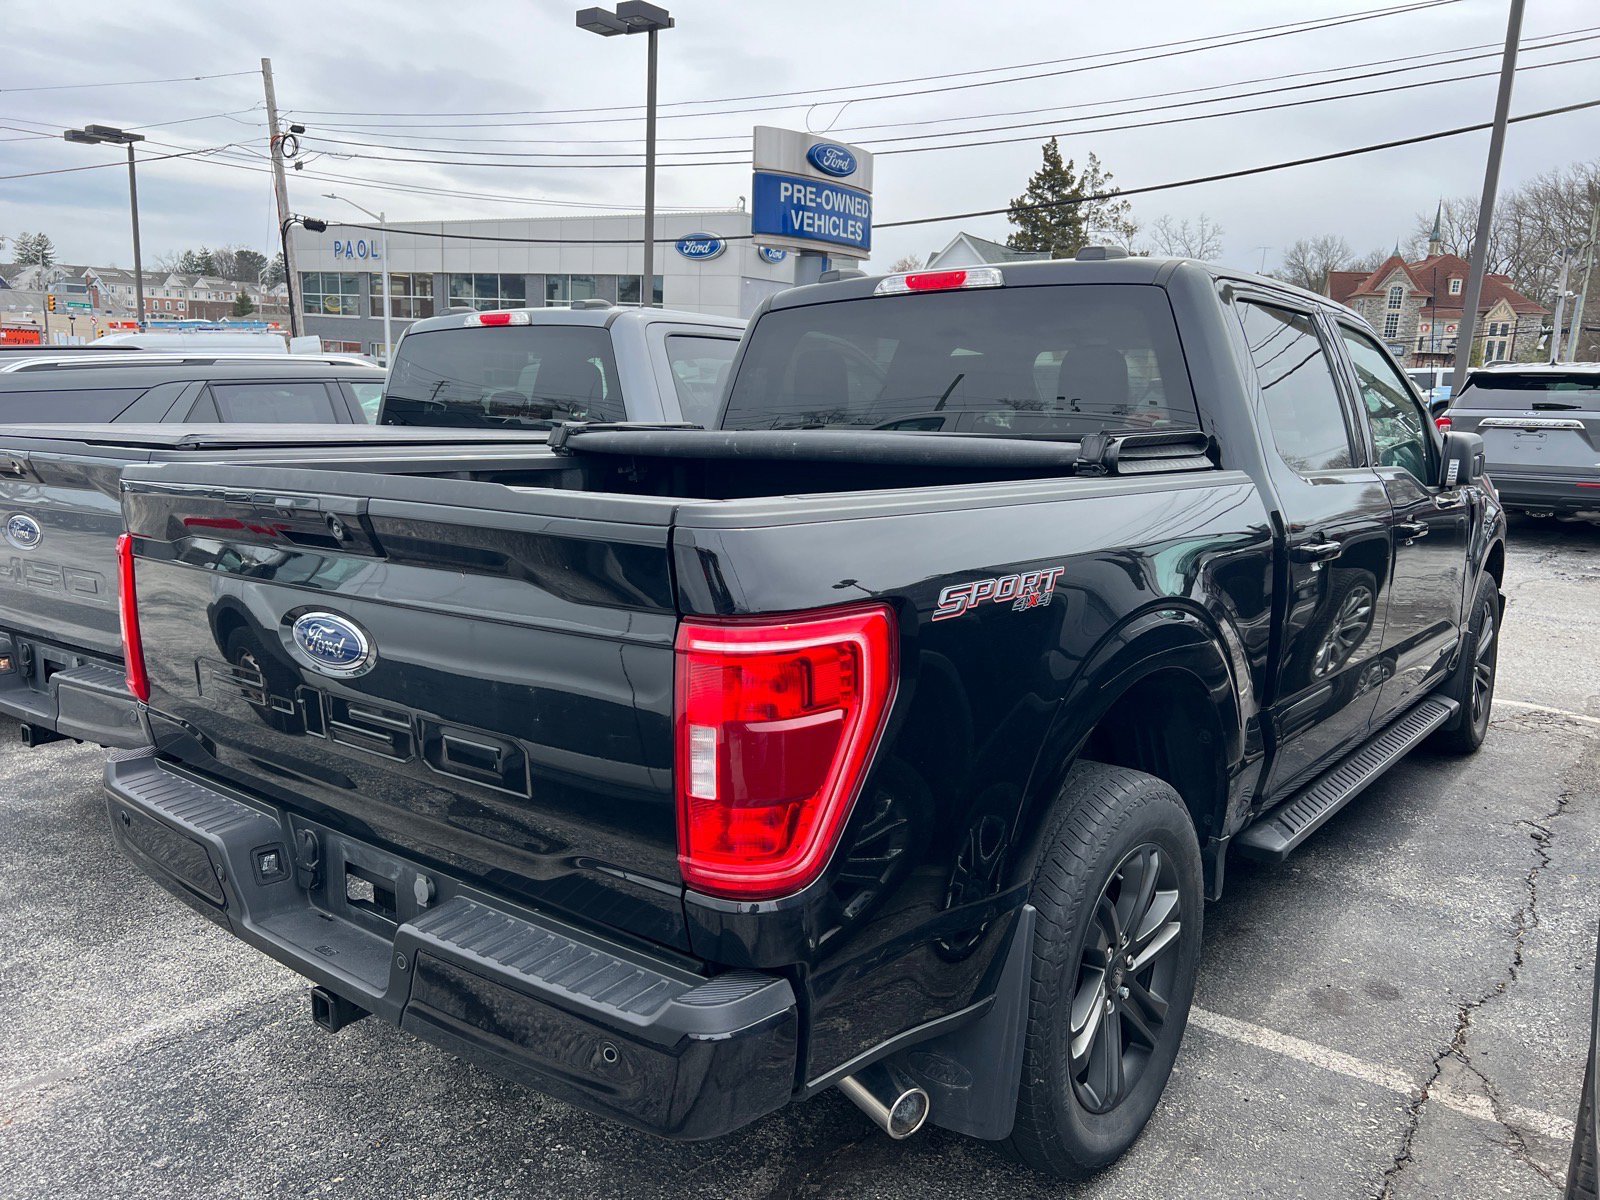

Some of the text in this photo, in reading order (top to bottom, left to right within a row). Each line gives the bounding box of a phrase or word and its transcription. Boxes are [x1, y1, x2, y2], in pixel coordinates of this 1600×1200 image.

[822, 148, 850, 171] Ford
[780, 182, 869, 219] PRE-OWNED
[790, 209, 864, 242] VEHICLES
[334, 240, 379, 258] PAOL
[931, 566, 1065, 622] SPORT
[304, 623, 346, 659] Ford
[194, 656, 533, 799] F-150
